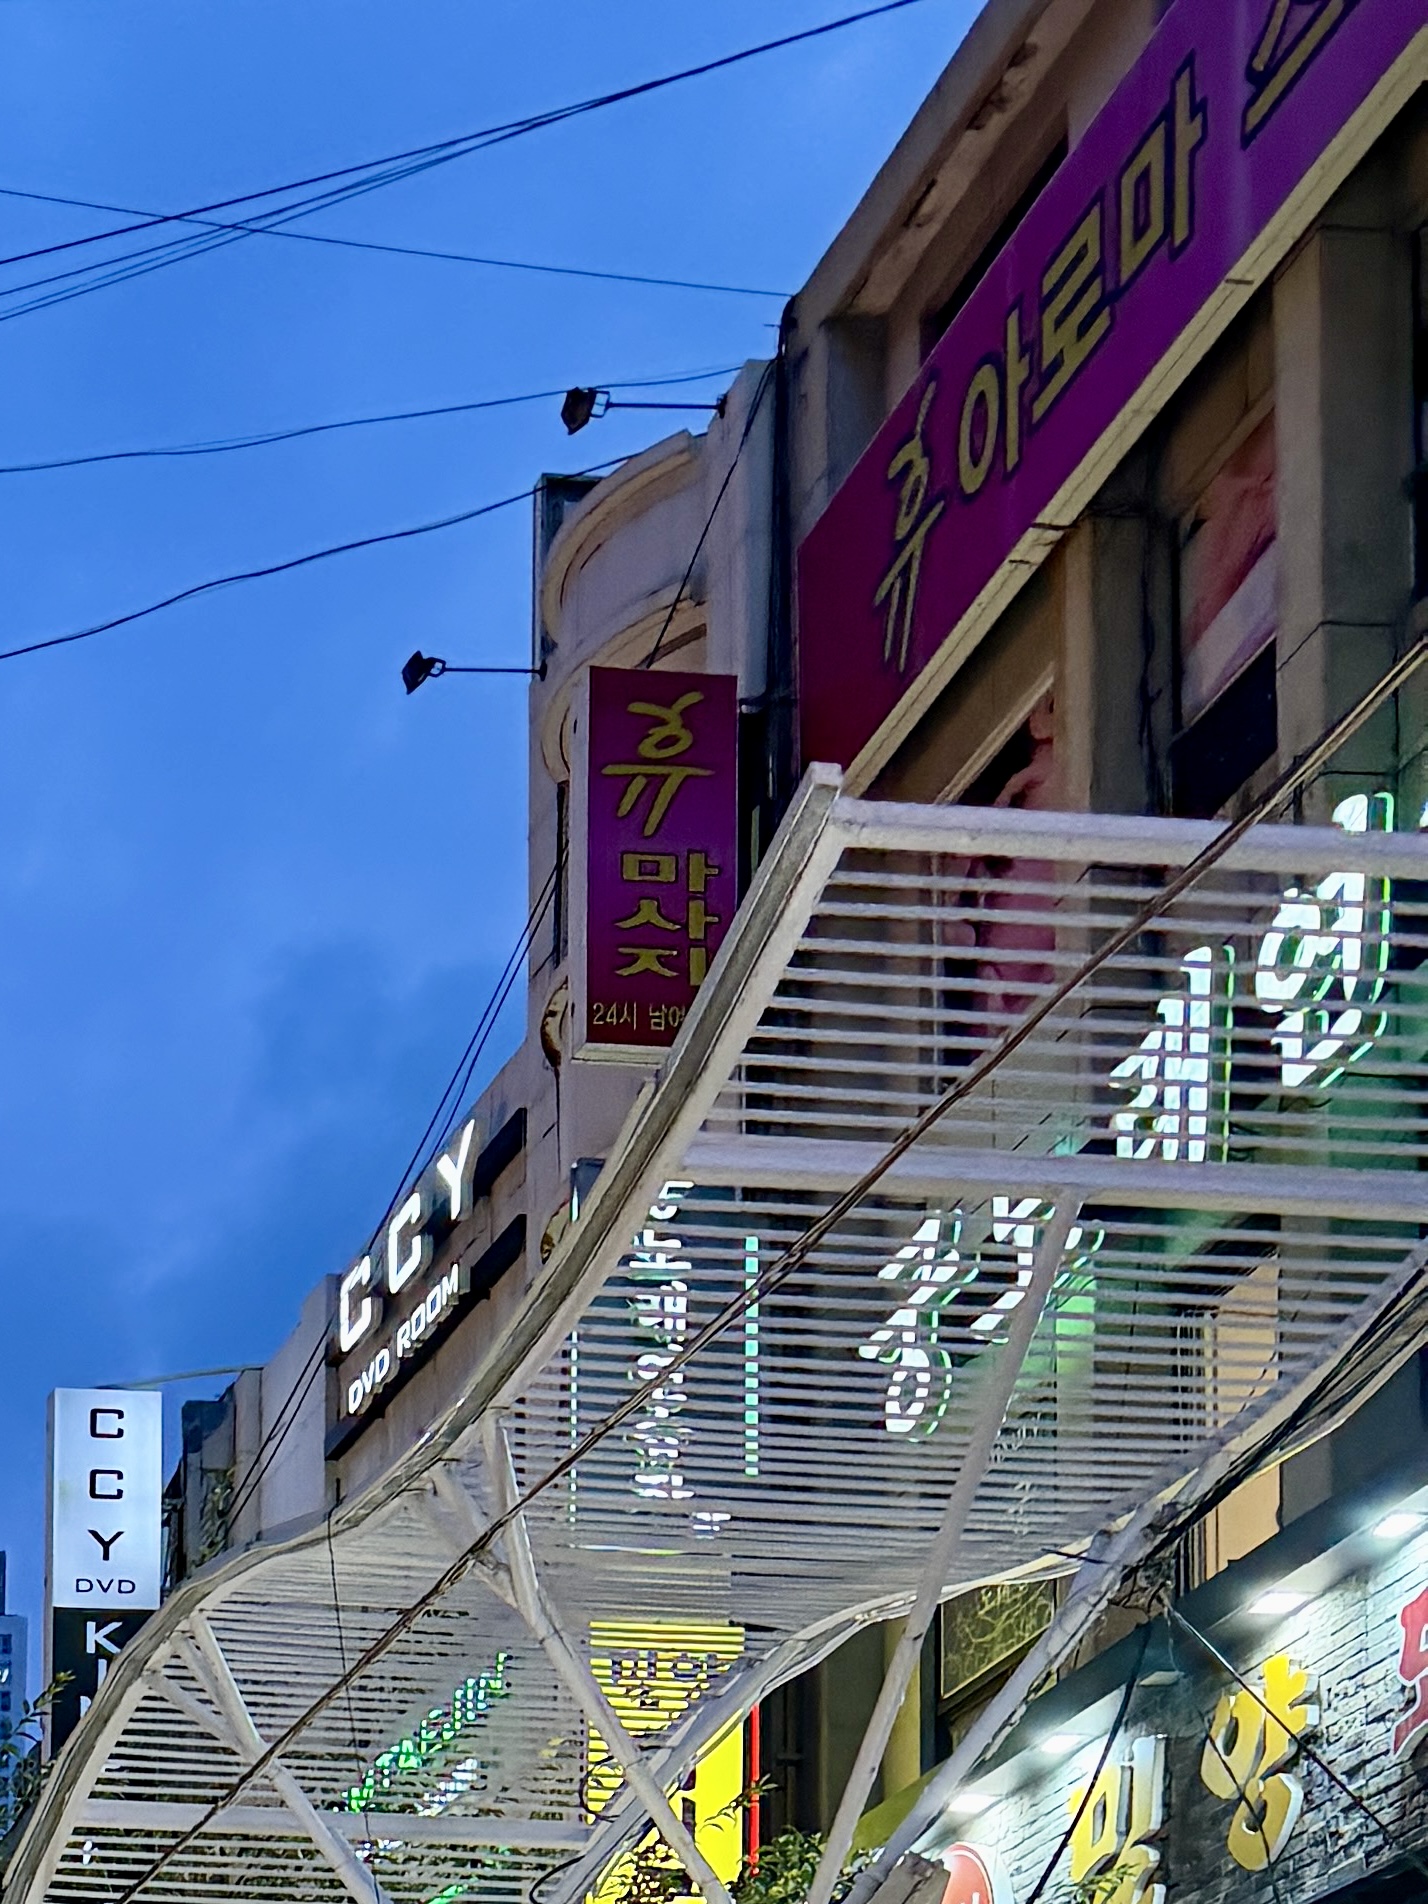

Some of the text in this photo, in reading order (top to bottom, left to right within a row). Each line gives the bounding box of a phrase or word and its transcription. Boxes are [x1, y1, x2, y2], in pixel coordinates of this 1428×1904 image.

[958, 55, 1204, 495] 아로마
[600, 690, 716, 837] 휴
[614, 851, 720, 986] 마사지
[593, 1002, 638, 1031] 24시
[340, 1119, 476, 1353] CCY
[348, 1262, 460, 1415] DVD ROOM
[88, 1408, 125, 1561] CCY
[75, 1578, 137, 1595] DVD
